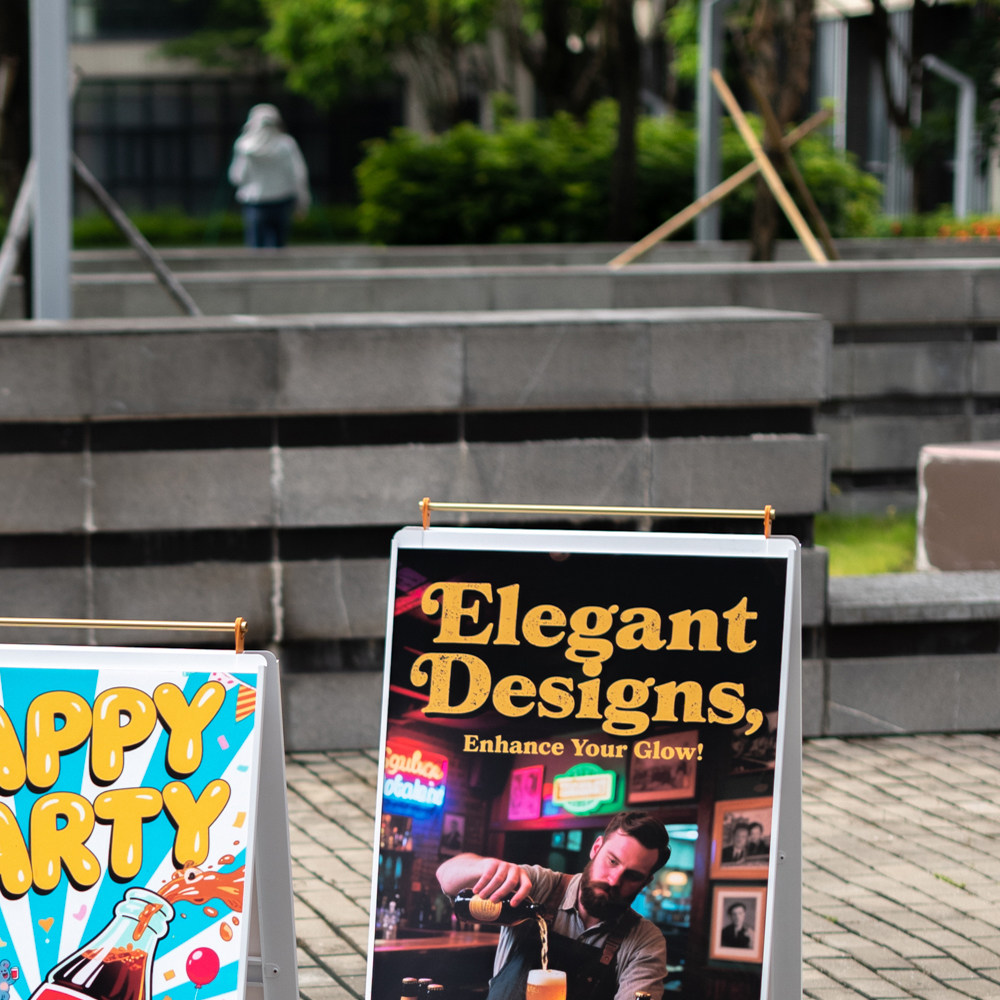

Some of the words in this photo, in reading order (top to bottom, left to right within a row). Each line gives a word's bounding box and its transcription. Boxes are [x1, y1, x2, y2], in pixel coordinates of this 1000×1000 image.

[421, 581, 758, 664] Elegant
[410, 652, 764, 736] Designs,
[463, 734, 564, 756] Enhance
[571, 738, 628, 758] Your
[634, 740, 704, 761] Glow!
